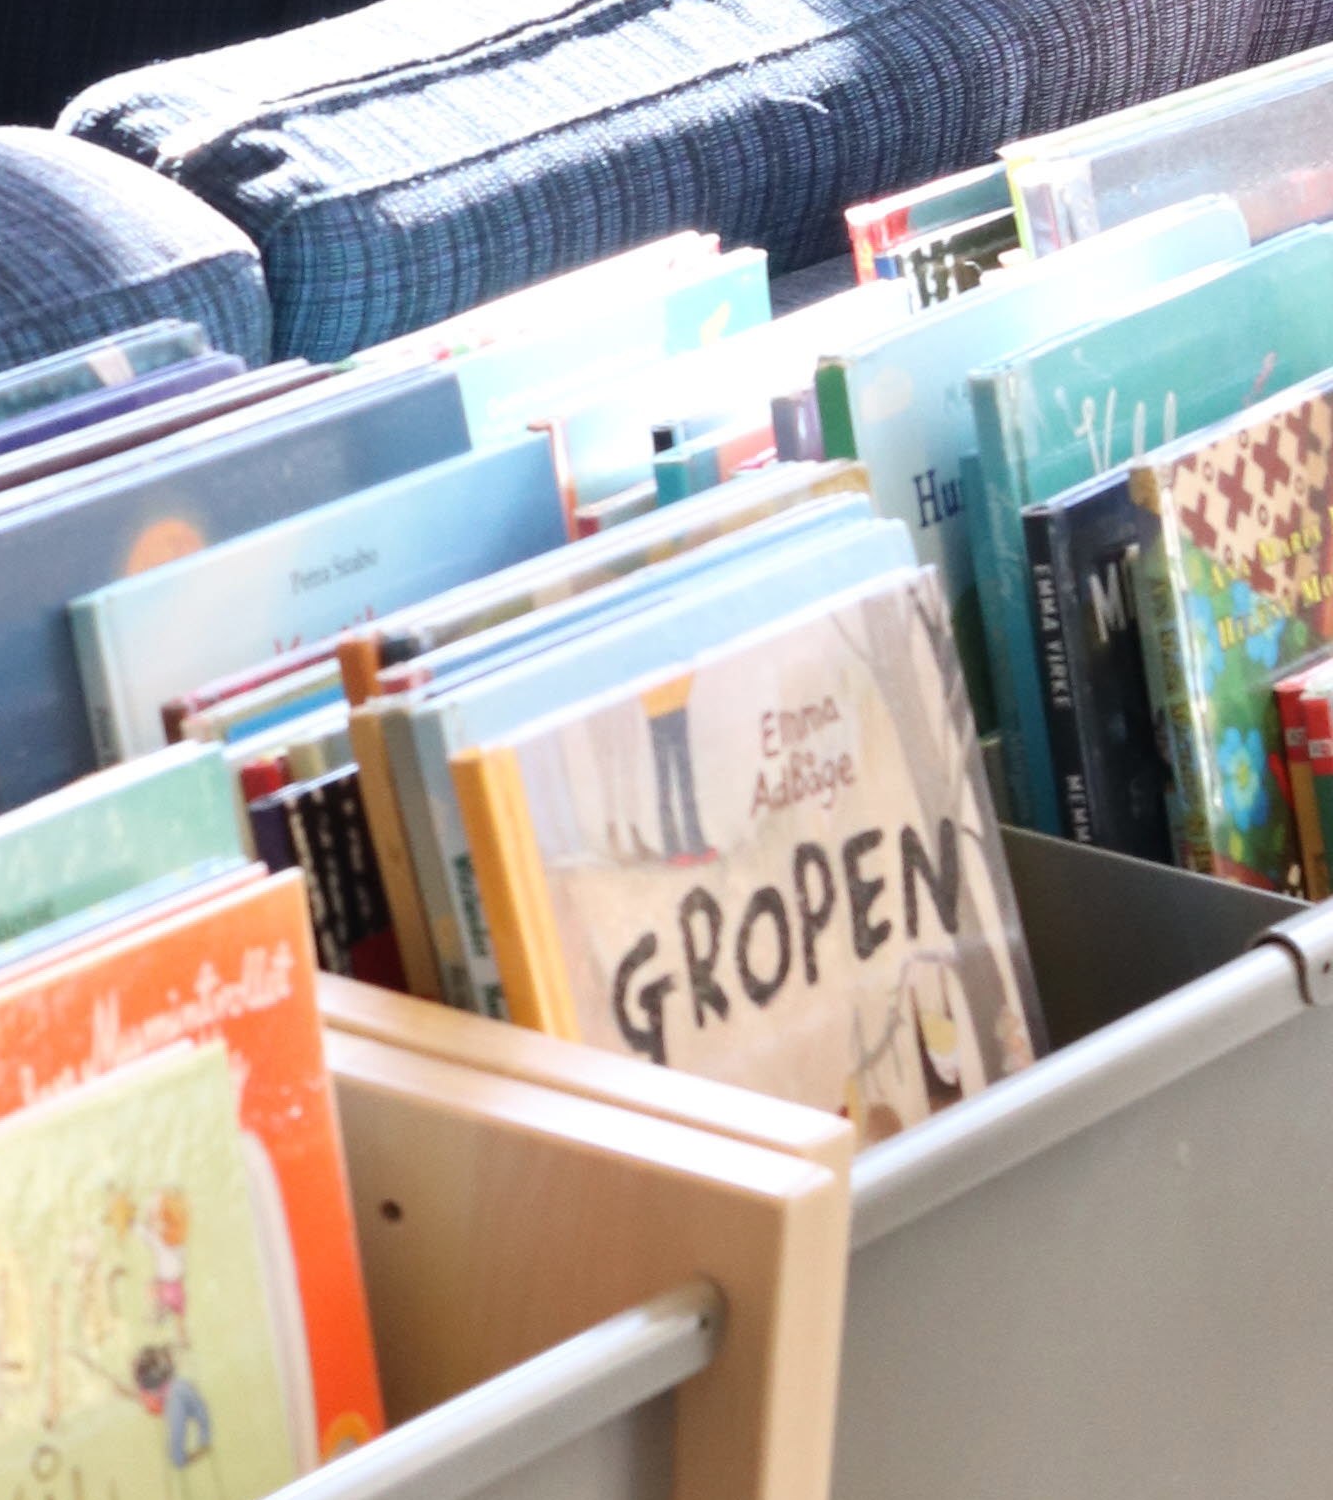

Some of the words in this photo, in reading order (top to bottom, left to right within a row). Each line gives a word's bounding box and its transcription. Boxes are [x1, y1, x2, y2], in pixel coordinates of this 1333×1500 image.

[1034, 562, 1061, 632] EMMA
[1045, 639, 1072, 709] VIRKE
[759, 696, 841, 758] Emma
[612, 815, 961, 1064] GROPEN
